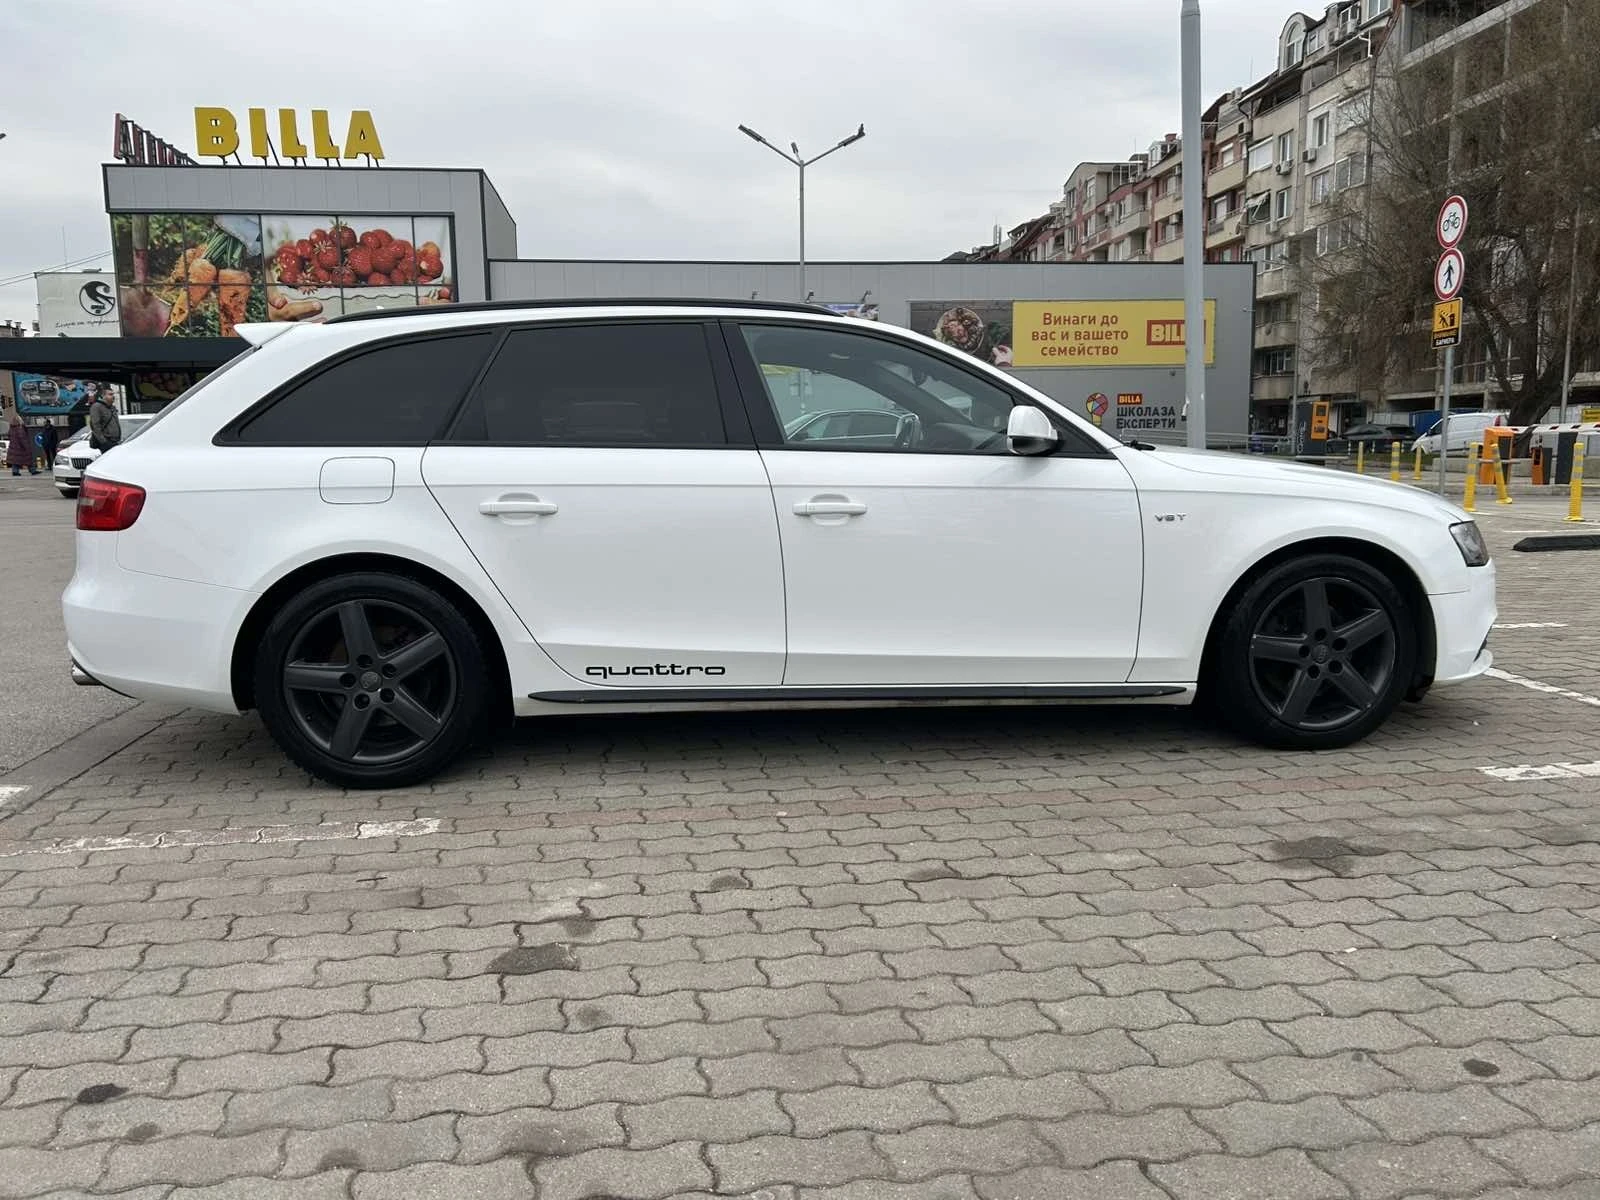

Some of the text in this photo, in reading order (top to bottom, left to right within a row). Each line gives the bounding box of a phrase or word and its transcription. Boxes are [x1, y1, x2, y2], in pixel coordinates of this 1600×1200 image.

[194, 106, 385, 160] BILLA
[1042, 312, 1119, 327] Винаги до
[1031, 329, 1129, 341] вас и вашето
[1040, 342, 1119, 356] семейство
[1119, 395, 1141, 404] BILLA
[1116, 418, 1176, 429] ЕКСПЕРТИ
[586, 663, 726, 679] quattro
